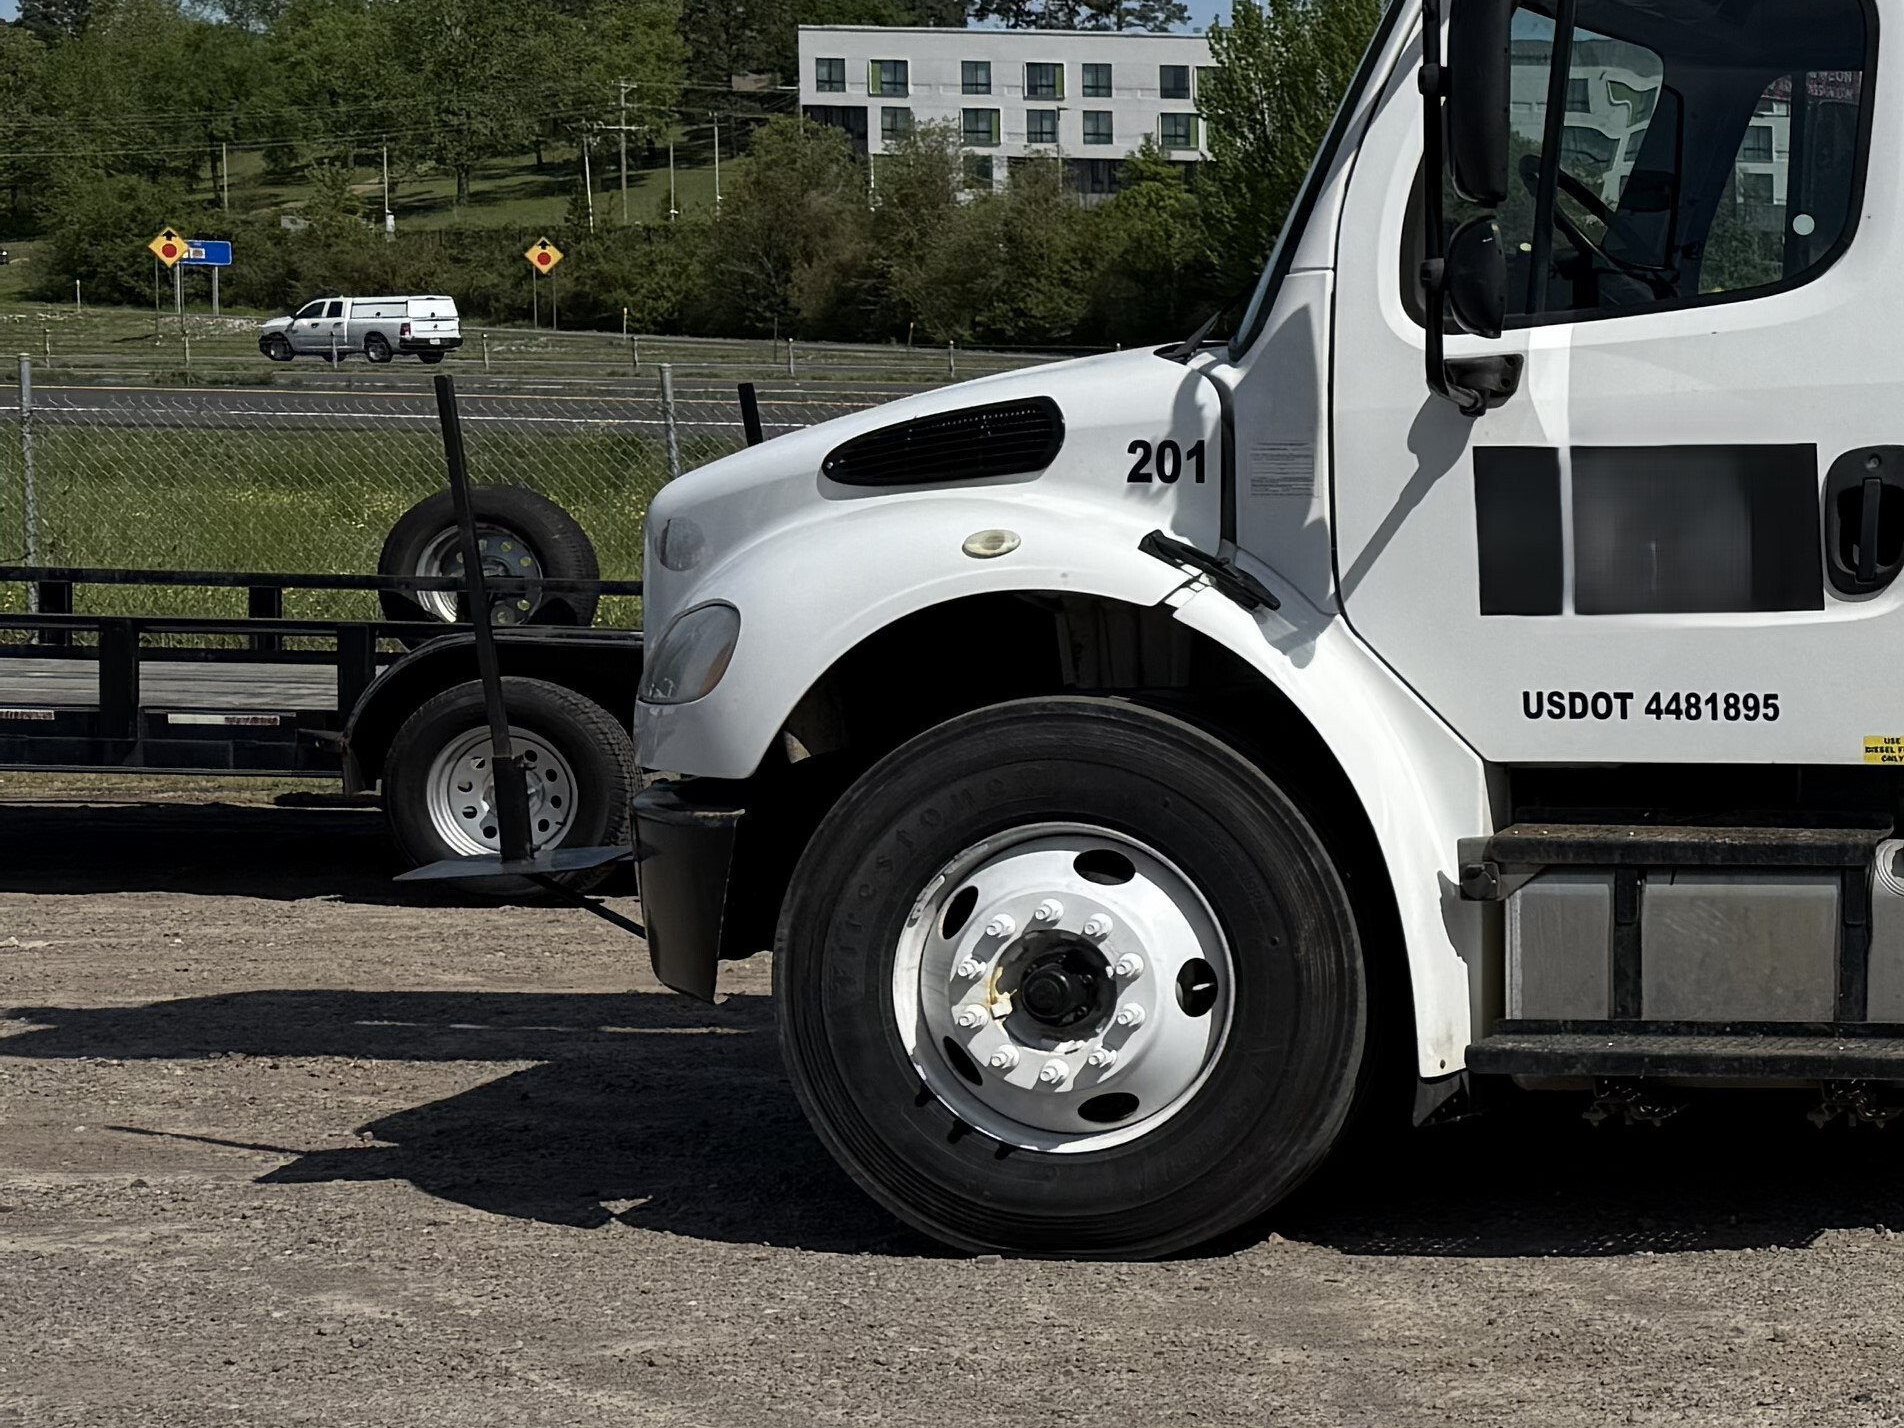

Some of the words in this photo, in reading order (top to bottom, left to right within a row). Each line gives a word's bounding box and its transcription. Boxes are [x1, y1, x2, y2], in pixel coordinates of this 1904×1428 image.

[1126, 439, 1206, 484] 201
[1522, 691, 1634, 720] USDOT
[1644, 691, 1780, 722] 4481895
